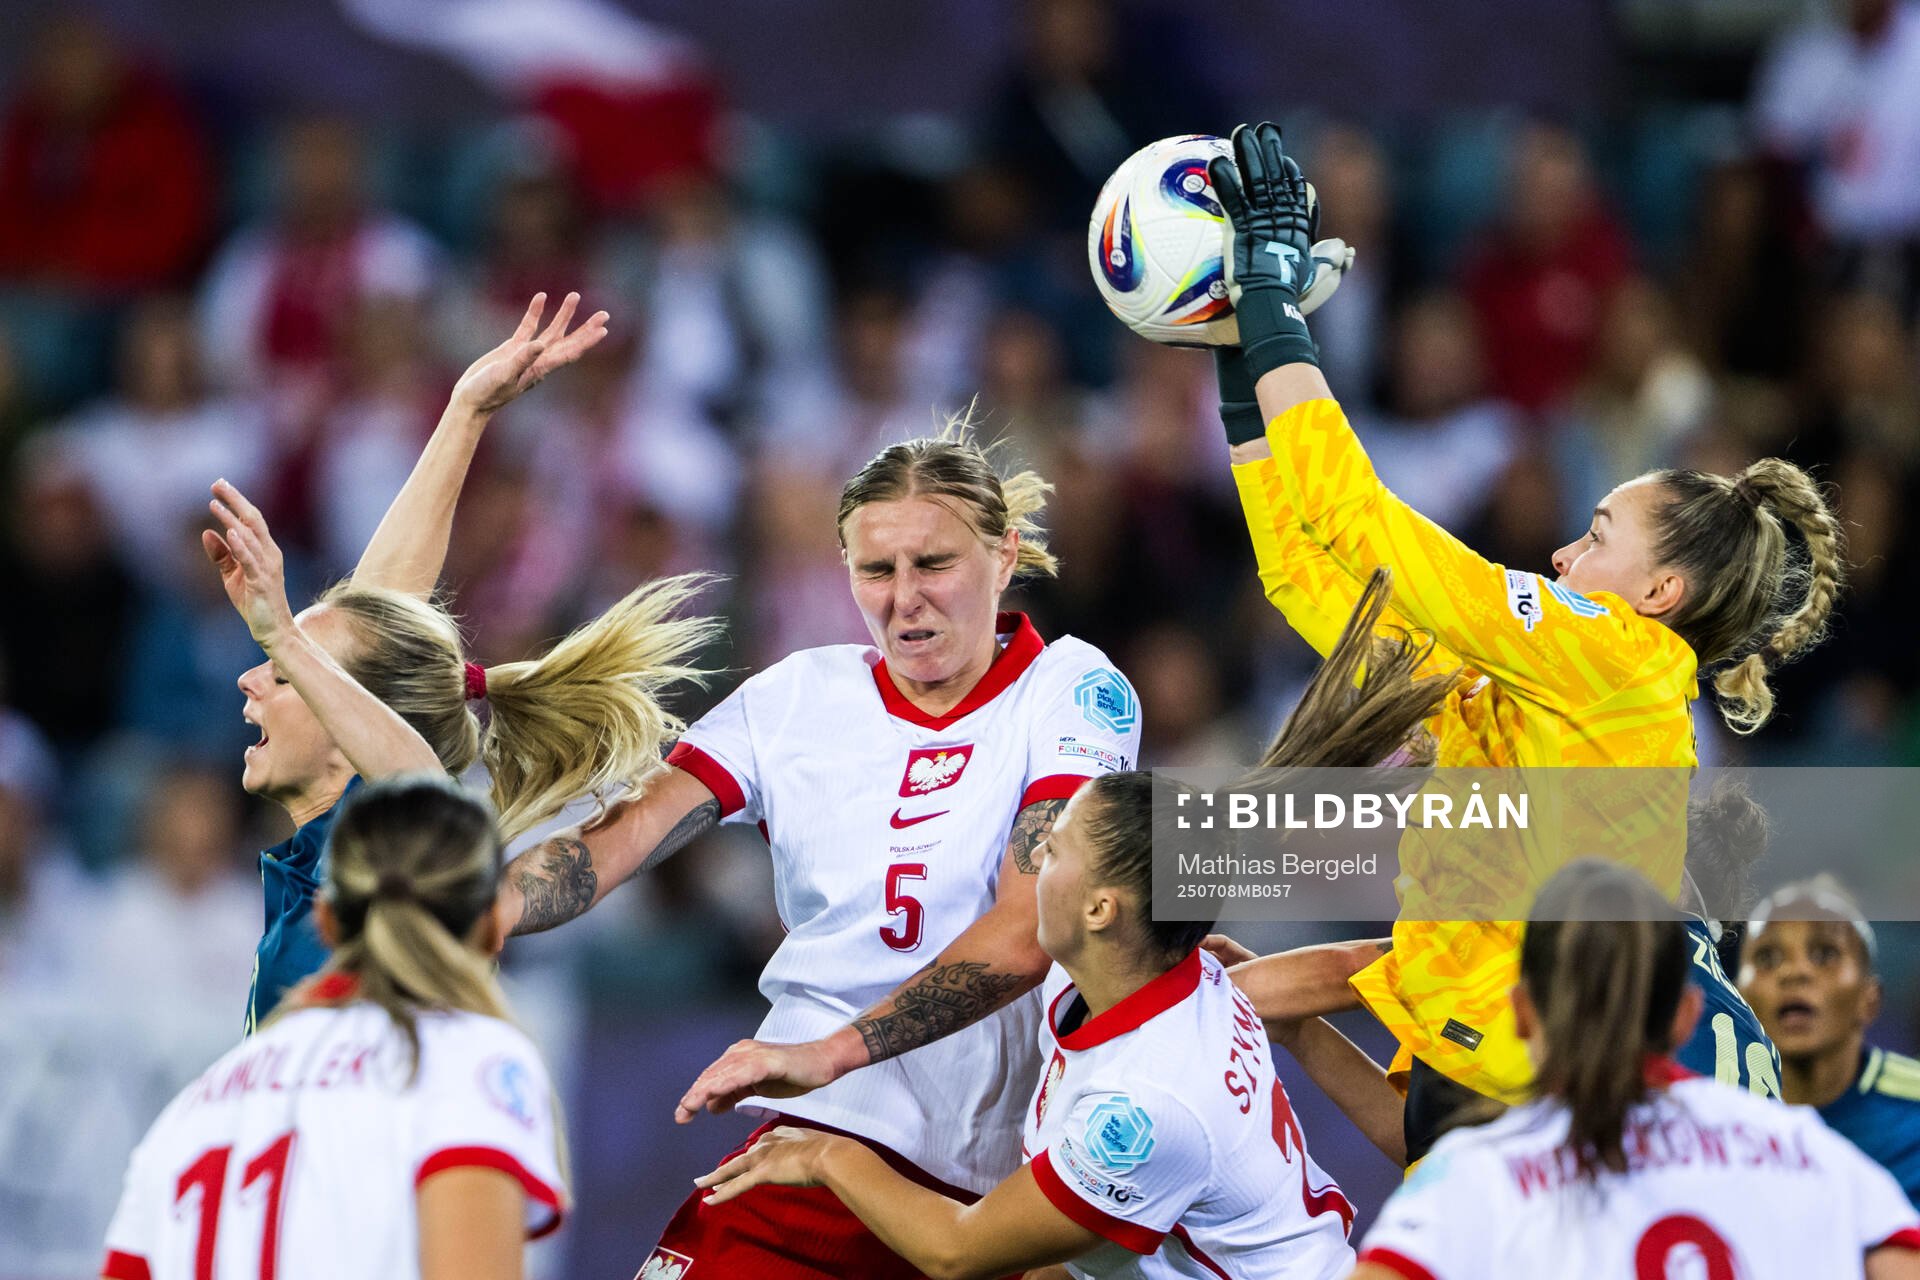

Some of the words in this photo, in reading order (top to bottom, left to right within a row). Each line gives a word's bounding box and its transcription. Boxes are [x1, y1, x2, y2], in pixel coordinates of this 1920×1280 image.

[1058, 745, 1118, 764] FOUNDATION
[880, 863, 927, 952] 5
[174, 1129, 297, 1280] 11
